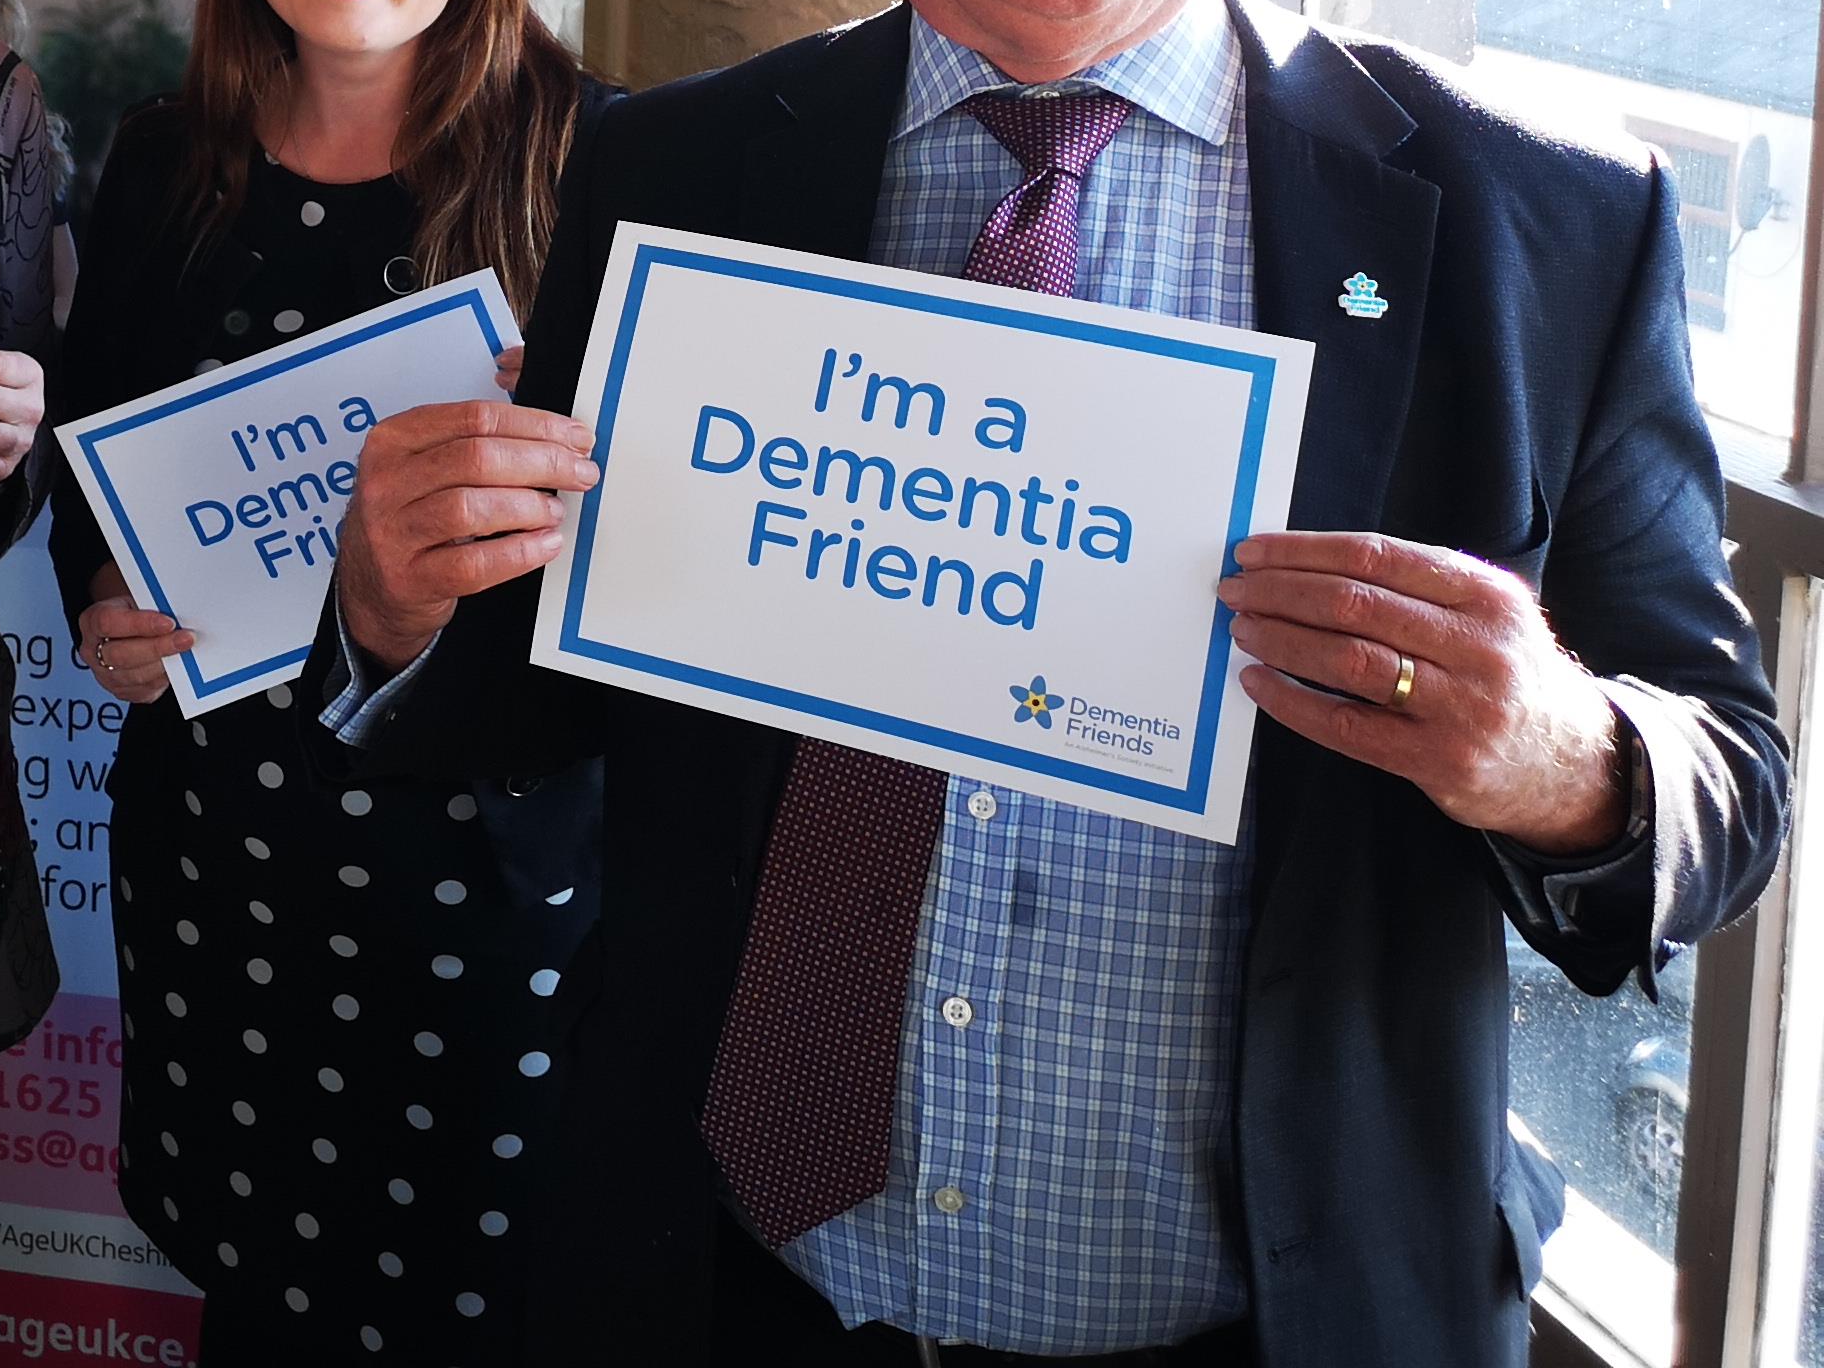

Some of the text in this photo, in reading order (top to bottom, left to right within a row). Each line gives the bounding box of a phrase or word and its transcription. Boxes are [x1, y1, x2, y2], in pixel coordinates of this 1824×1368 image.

[230, 395, 378, 473] I'm a
[814, 347, 1028, 453] I'm a
[184, 460, 357, 547] Deme
[689, 403, 1134, 565] Dementia
[254, 514, 343, 579] Fri
[746, 498, 1044, 632] Friend
[10, 692, 124, 742] expe
[1066, 717, 1154, 756] Friends
[1069, 696, 1181, 740] Dementia
[42, 1019, 124, 1068] info
